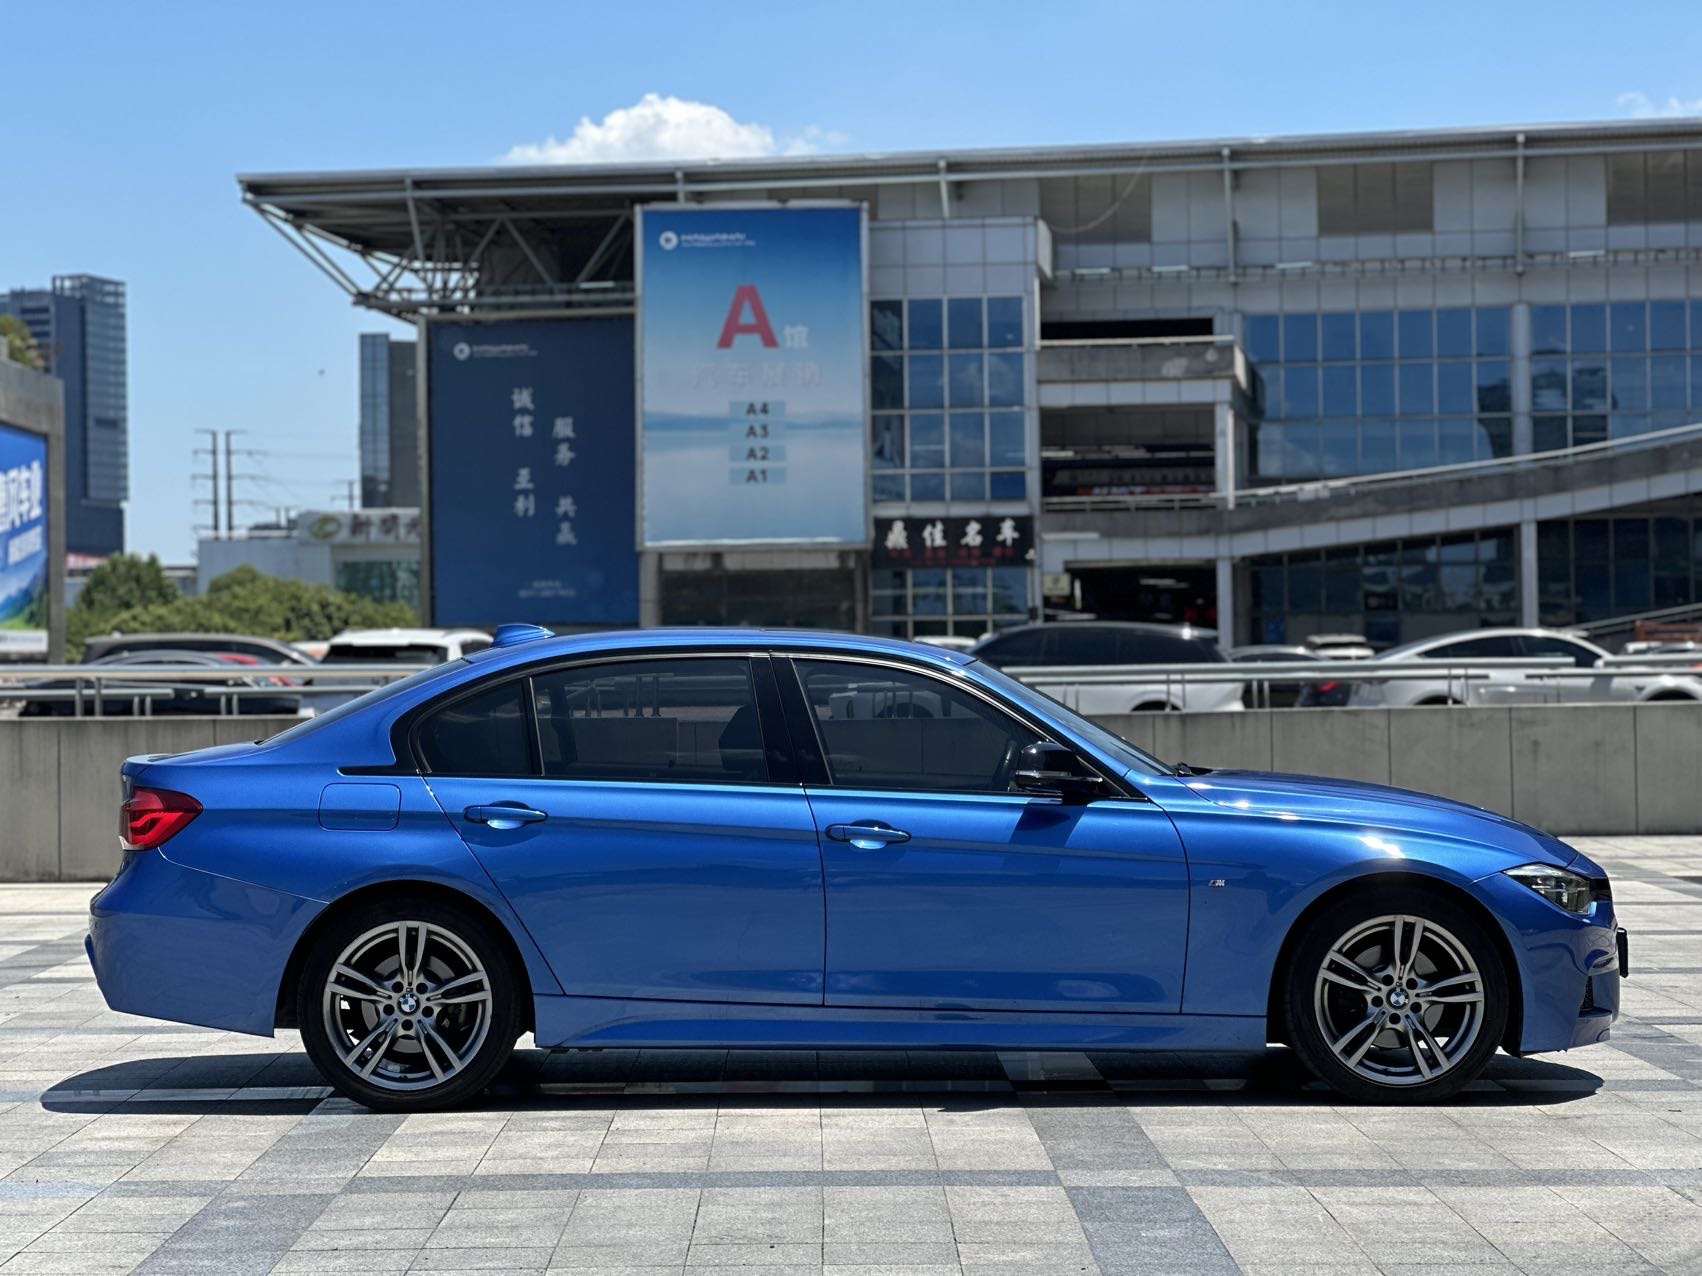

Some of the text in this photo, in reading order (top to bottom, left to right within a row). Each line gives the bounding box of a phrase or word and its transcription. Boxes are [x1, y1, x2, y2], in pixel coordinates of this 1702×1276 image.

[511, 387, 534, 437] 诚信
[746, 402, 769, 415] A4
[745, 424, 769, 438] A3
[552, 417, 576, 466] 服务
[745, 447, 769, 461] A2
[745, 469, 768, 483] A1
